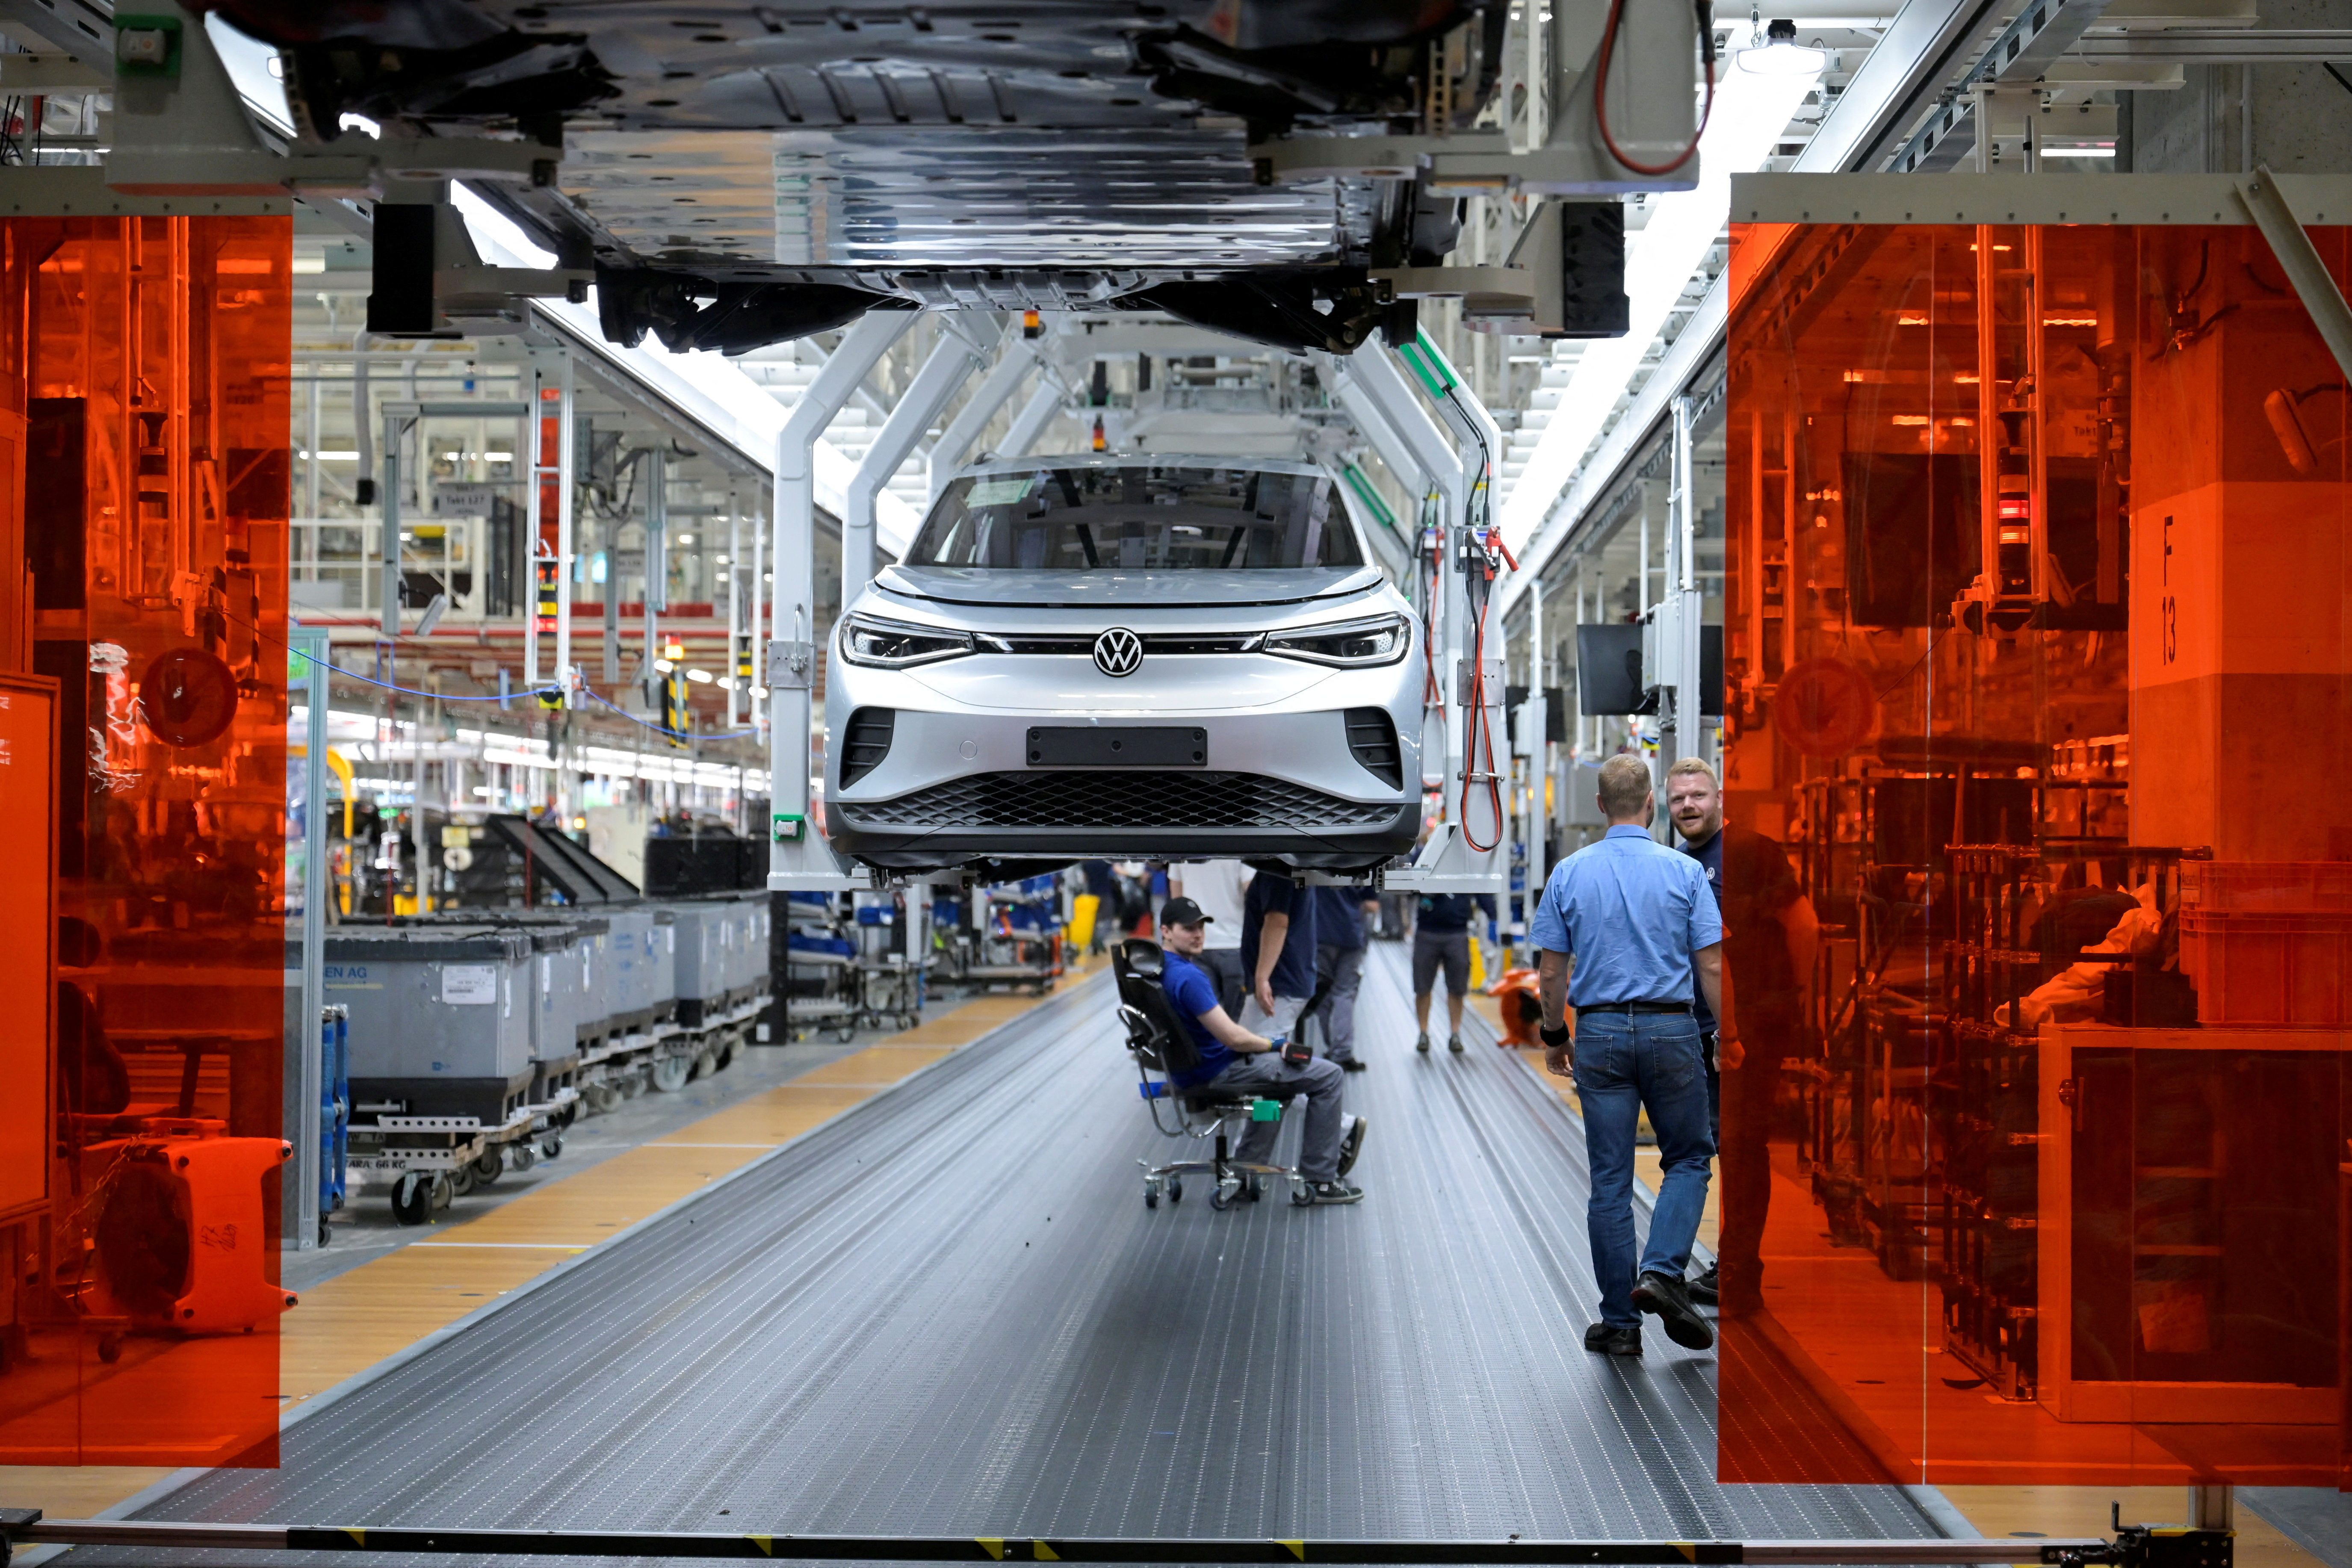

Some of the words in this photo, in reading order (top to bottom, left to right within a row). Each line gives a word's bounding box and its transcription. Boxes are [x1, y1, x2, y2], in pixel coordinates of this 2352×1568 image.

[2164, 515, 2173, 586] F
[1096, 630, 1140, 673] VW
[2163, 596, 2175, 665] 13
[1706, 867, 1715, 880] VW
[324, 966, 343, 978] EN
[348, 966, 367, 978] AG
